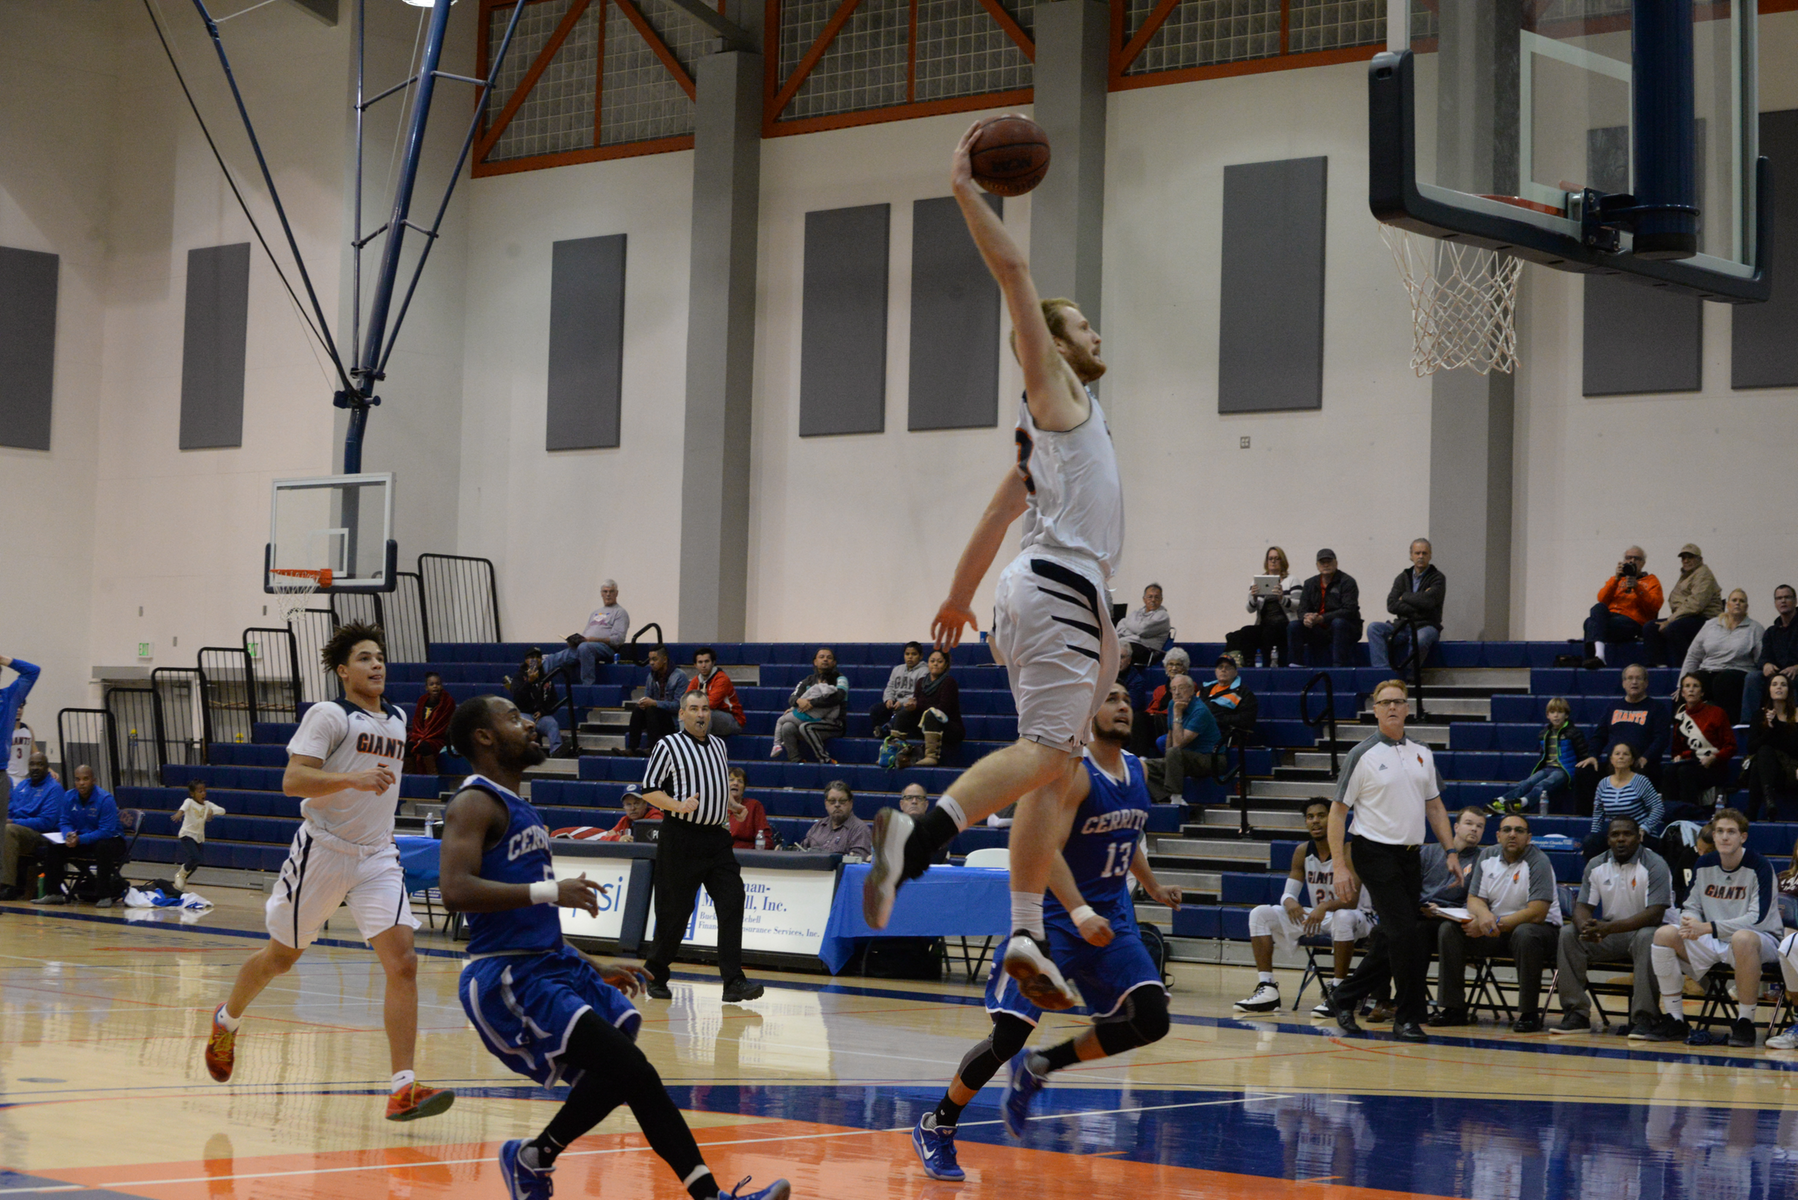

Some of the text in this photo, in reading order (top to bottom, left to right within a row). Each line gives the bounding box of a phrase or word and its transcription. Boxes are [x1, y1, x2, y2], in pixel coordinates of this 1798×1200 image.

[1611, 709, 1648, 725] GIANTS
[356, 732, 405, 761] GIANT
[1101, 842, 1132, 878] 13
[1308, 871, 1334, 885] GIANT
[1704, 884, 1747, 899] GIANTS
[762, 896, 787, 911] Inc.
[774, 926, 804, 937] Services,
[806, 929, 820, 937] Inc.
